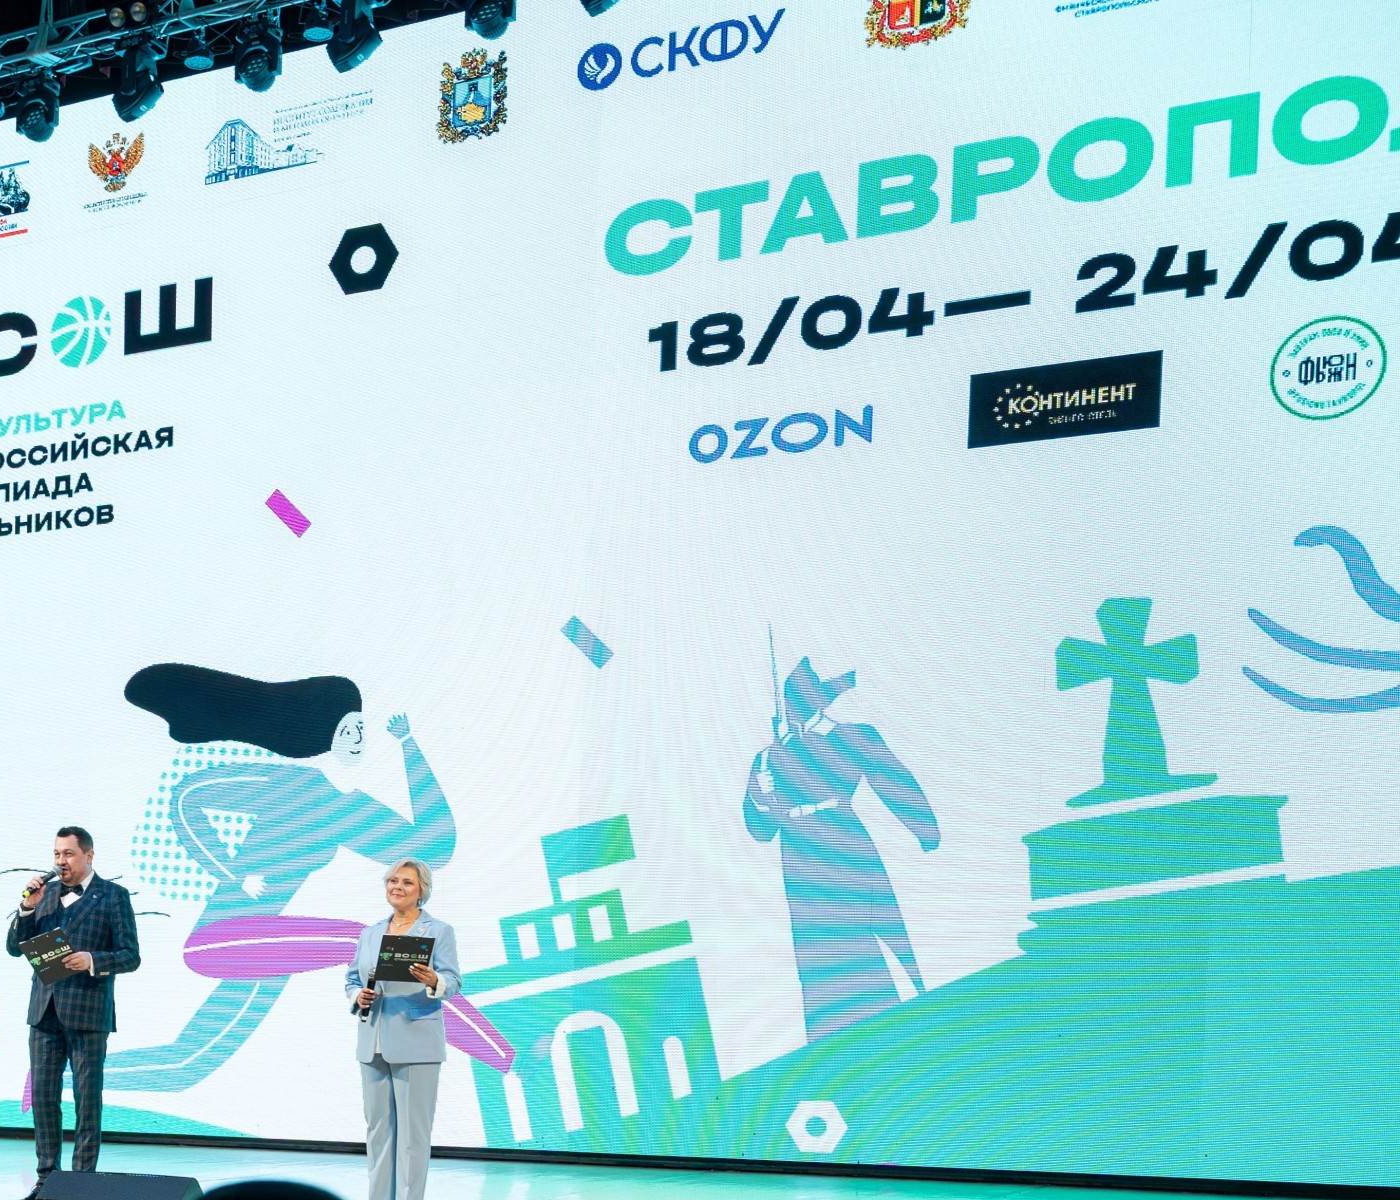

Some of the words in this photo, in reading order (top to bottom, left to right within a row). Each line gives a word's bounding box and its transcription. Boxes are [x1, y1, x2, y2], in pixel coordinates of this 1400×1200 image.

[631, 8, 786, 79] СКФУ
[1008, 382, 1137, 415] КОНТИНЕНТ
[688, 403, 874, 465] OZON
